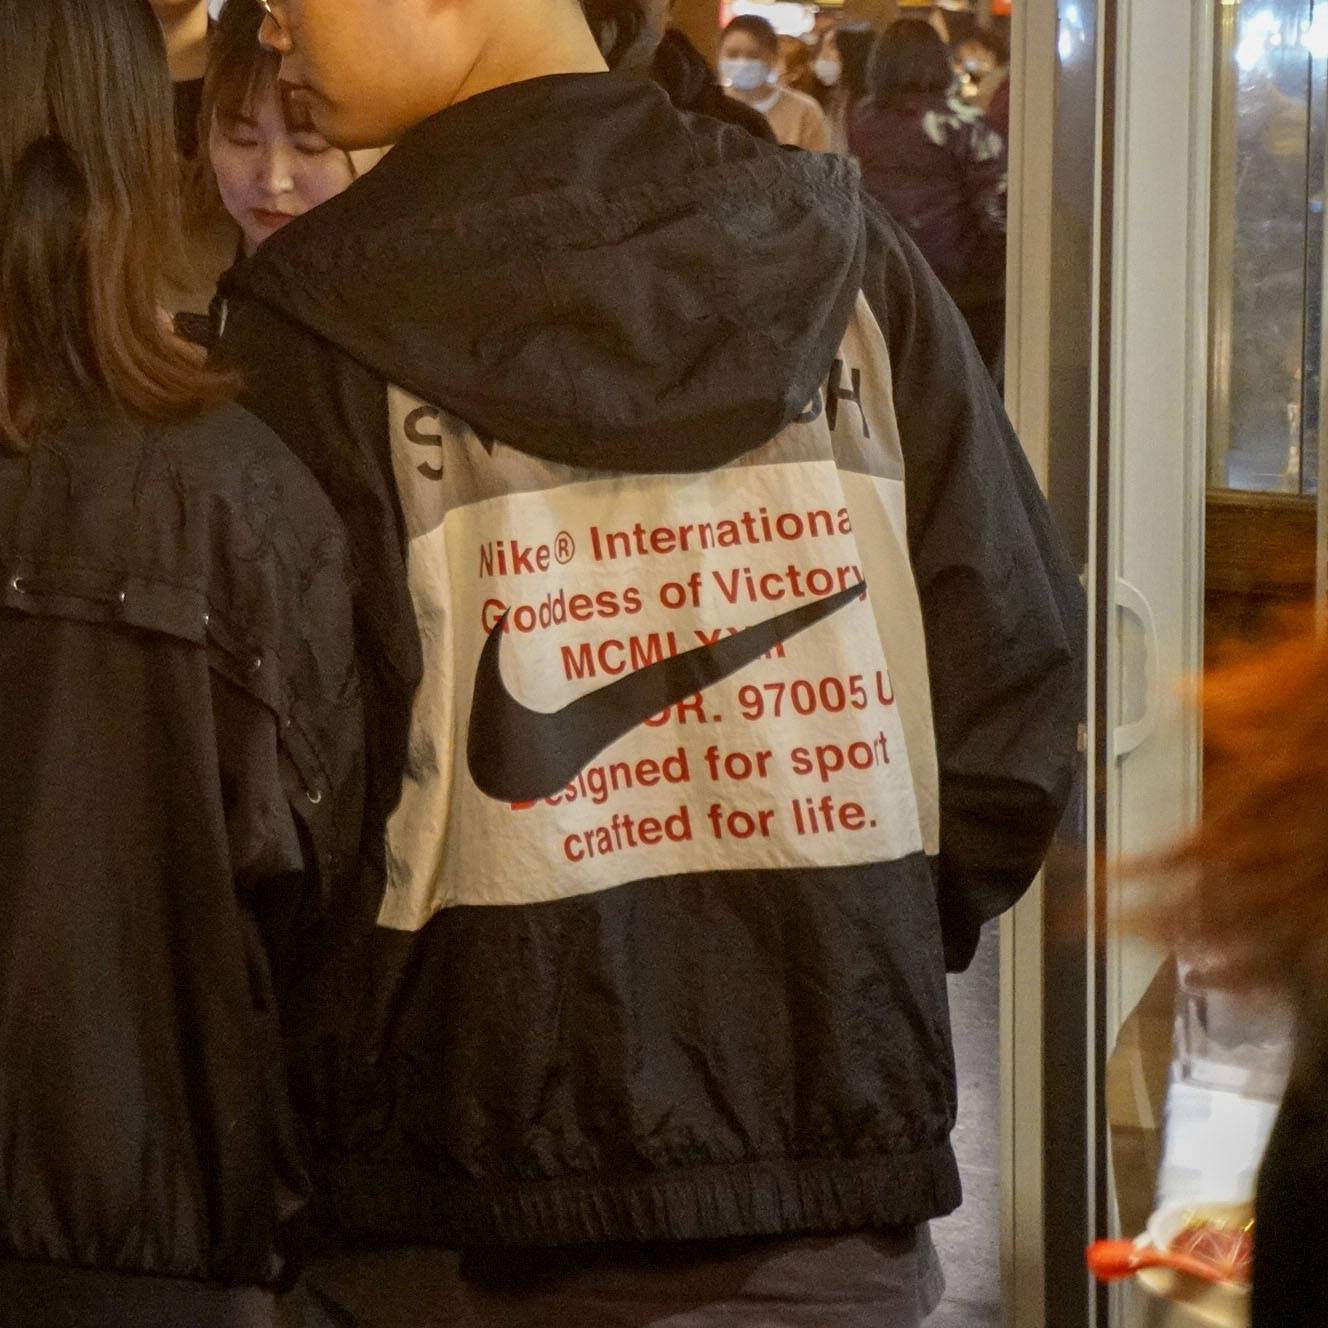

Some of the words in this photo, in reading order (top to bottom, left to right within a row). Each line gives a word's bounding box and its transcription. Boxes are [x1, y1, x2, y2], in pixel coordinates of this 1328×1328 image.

[482, 587, 643, 635] Goddess
[659, 573, 702, 610] of
[738, 675, 868, 721] 97005
[511, 747, 691, 811] signed
[705, 745, 773, 781] for
[790, 730, 891, 782] sport
[563, 805, 693, 863] crafted
[708, 803, 775, 840] for
[791, 795, 878, 836] life.
